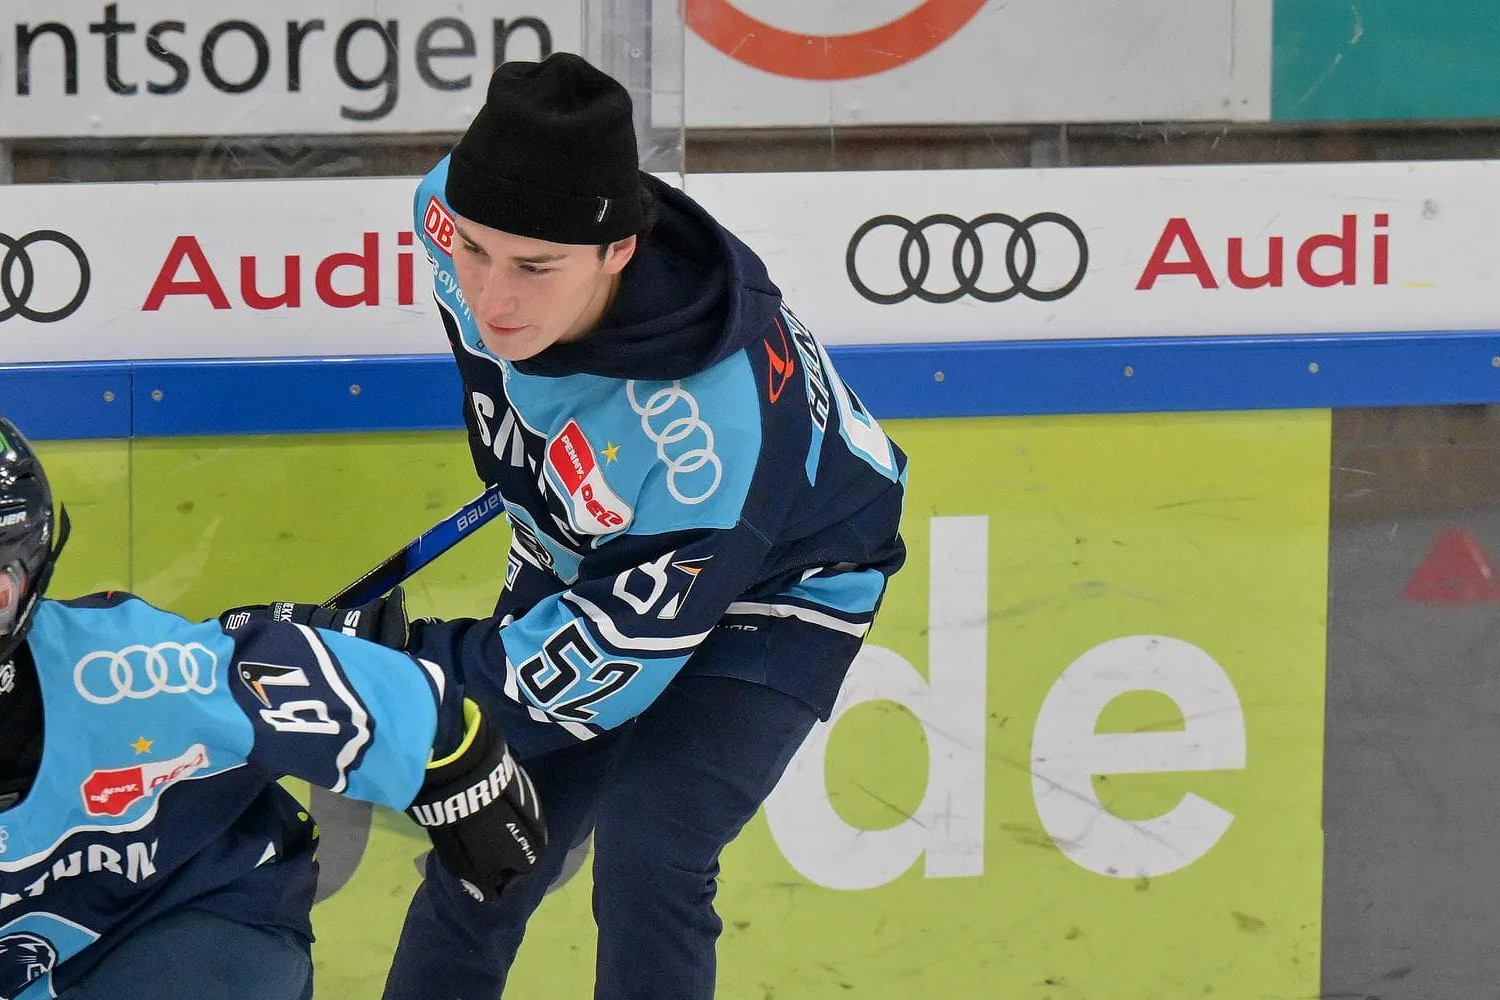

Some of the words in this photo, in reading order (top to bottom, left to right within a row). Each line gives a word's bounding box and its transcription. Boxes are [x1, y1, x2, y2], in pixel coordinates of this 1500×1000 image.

[426, 203, 455, 249] DB
[1135, 213, 1389, 291] Audi
[141, 231, 414, 312] Audi
[456, 490, 502, 532] BAUE
[518, 616, 643, 721] 52
[506, 822, 537, 865] ALPHA
